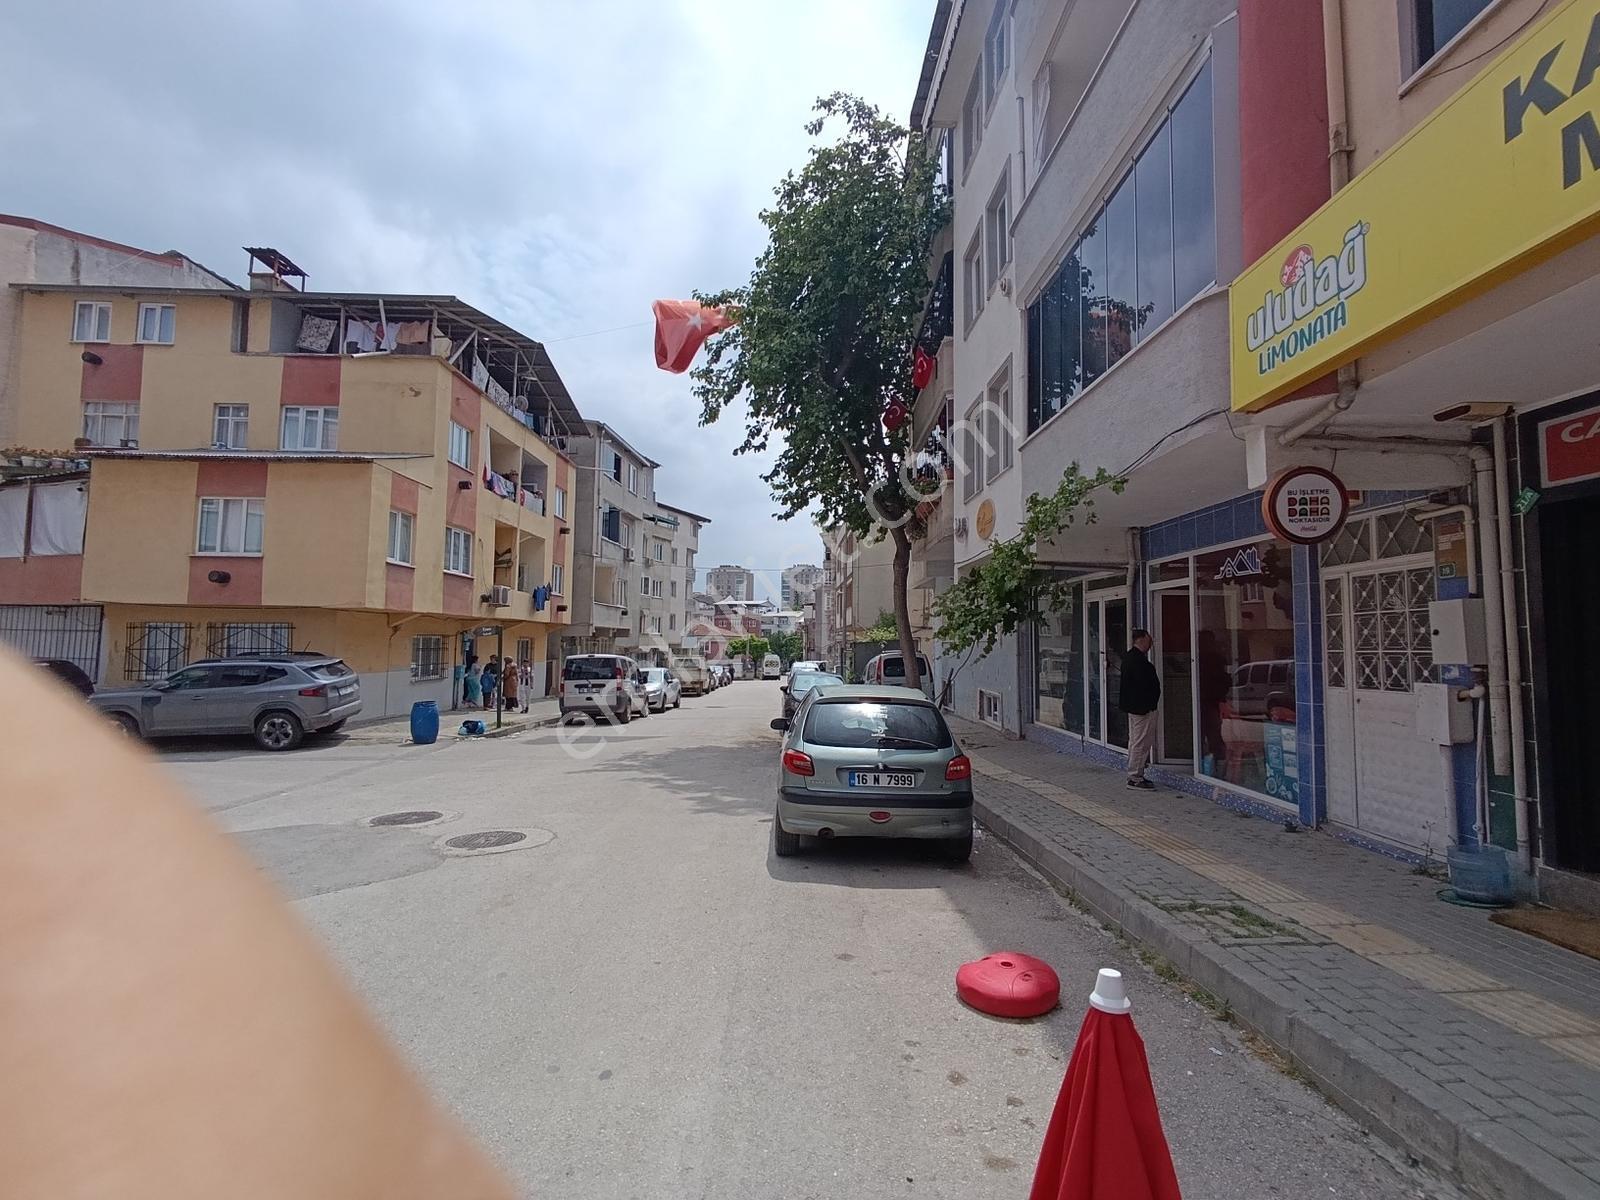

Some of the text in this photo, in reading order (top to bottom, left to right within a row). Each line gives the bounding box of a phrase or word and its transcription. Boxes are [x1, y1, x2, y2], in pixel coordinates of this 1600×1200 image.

[1246, 219, 1367, 352] uludağ
[1299, 488, 1330, 496] İŞLETME
[1287, 496, 1330, 507] DAHA
[1288, 507, 1330, 517] DAHA
[856, 774, 913, 786] 16 N 7999
